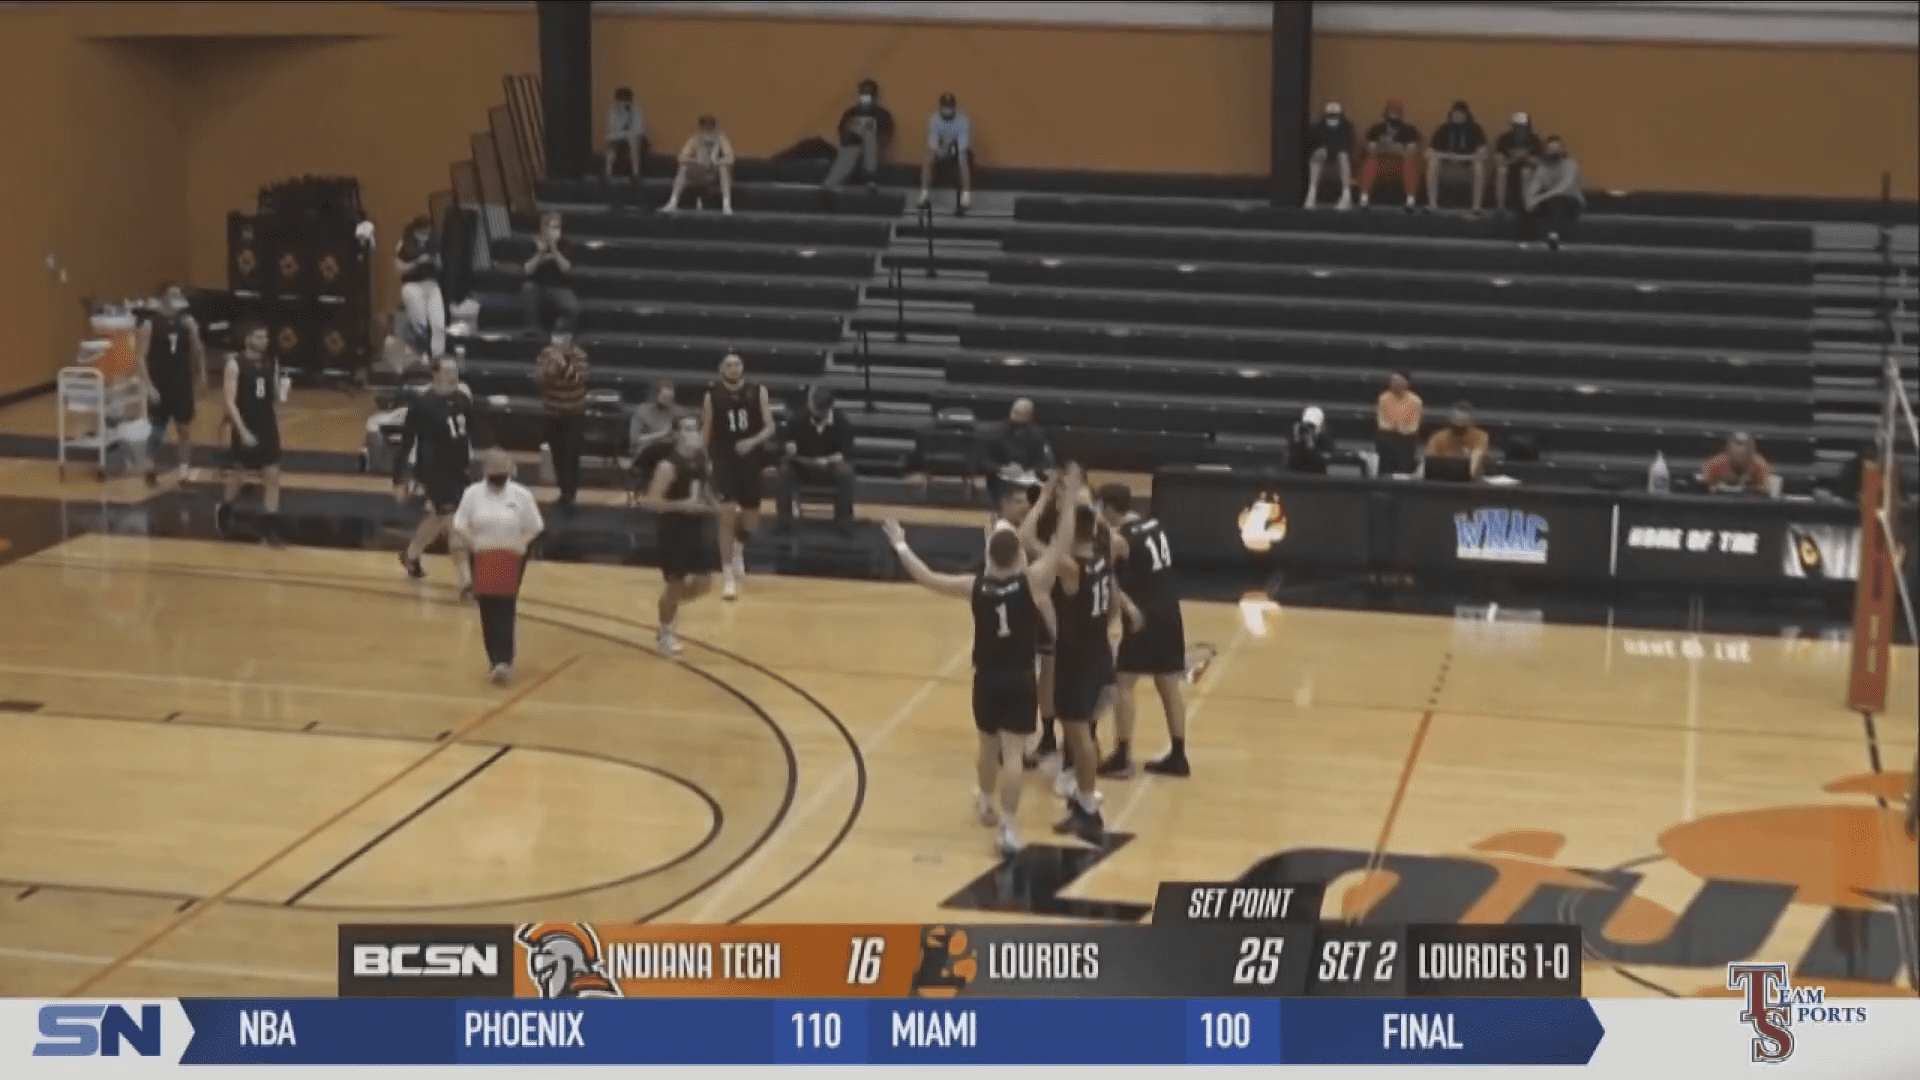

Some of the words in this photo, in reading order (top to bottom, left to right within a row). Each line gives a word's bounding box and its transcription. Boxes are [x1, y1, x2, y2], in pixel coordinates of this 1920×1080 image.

[727, 408, 749, 432] 18
[1144, 529, 1173, 573] 14
[995, 601, 1012, 638] 1
